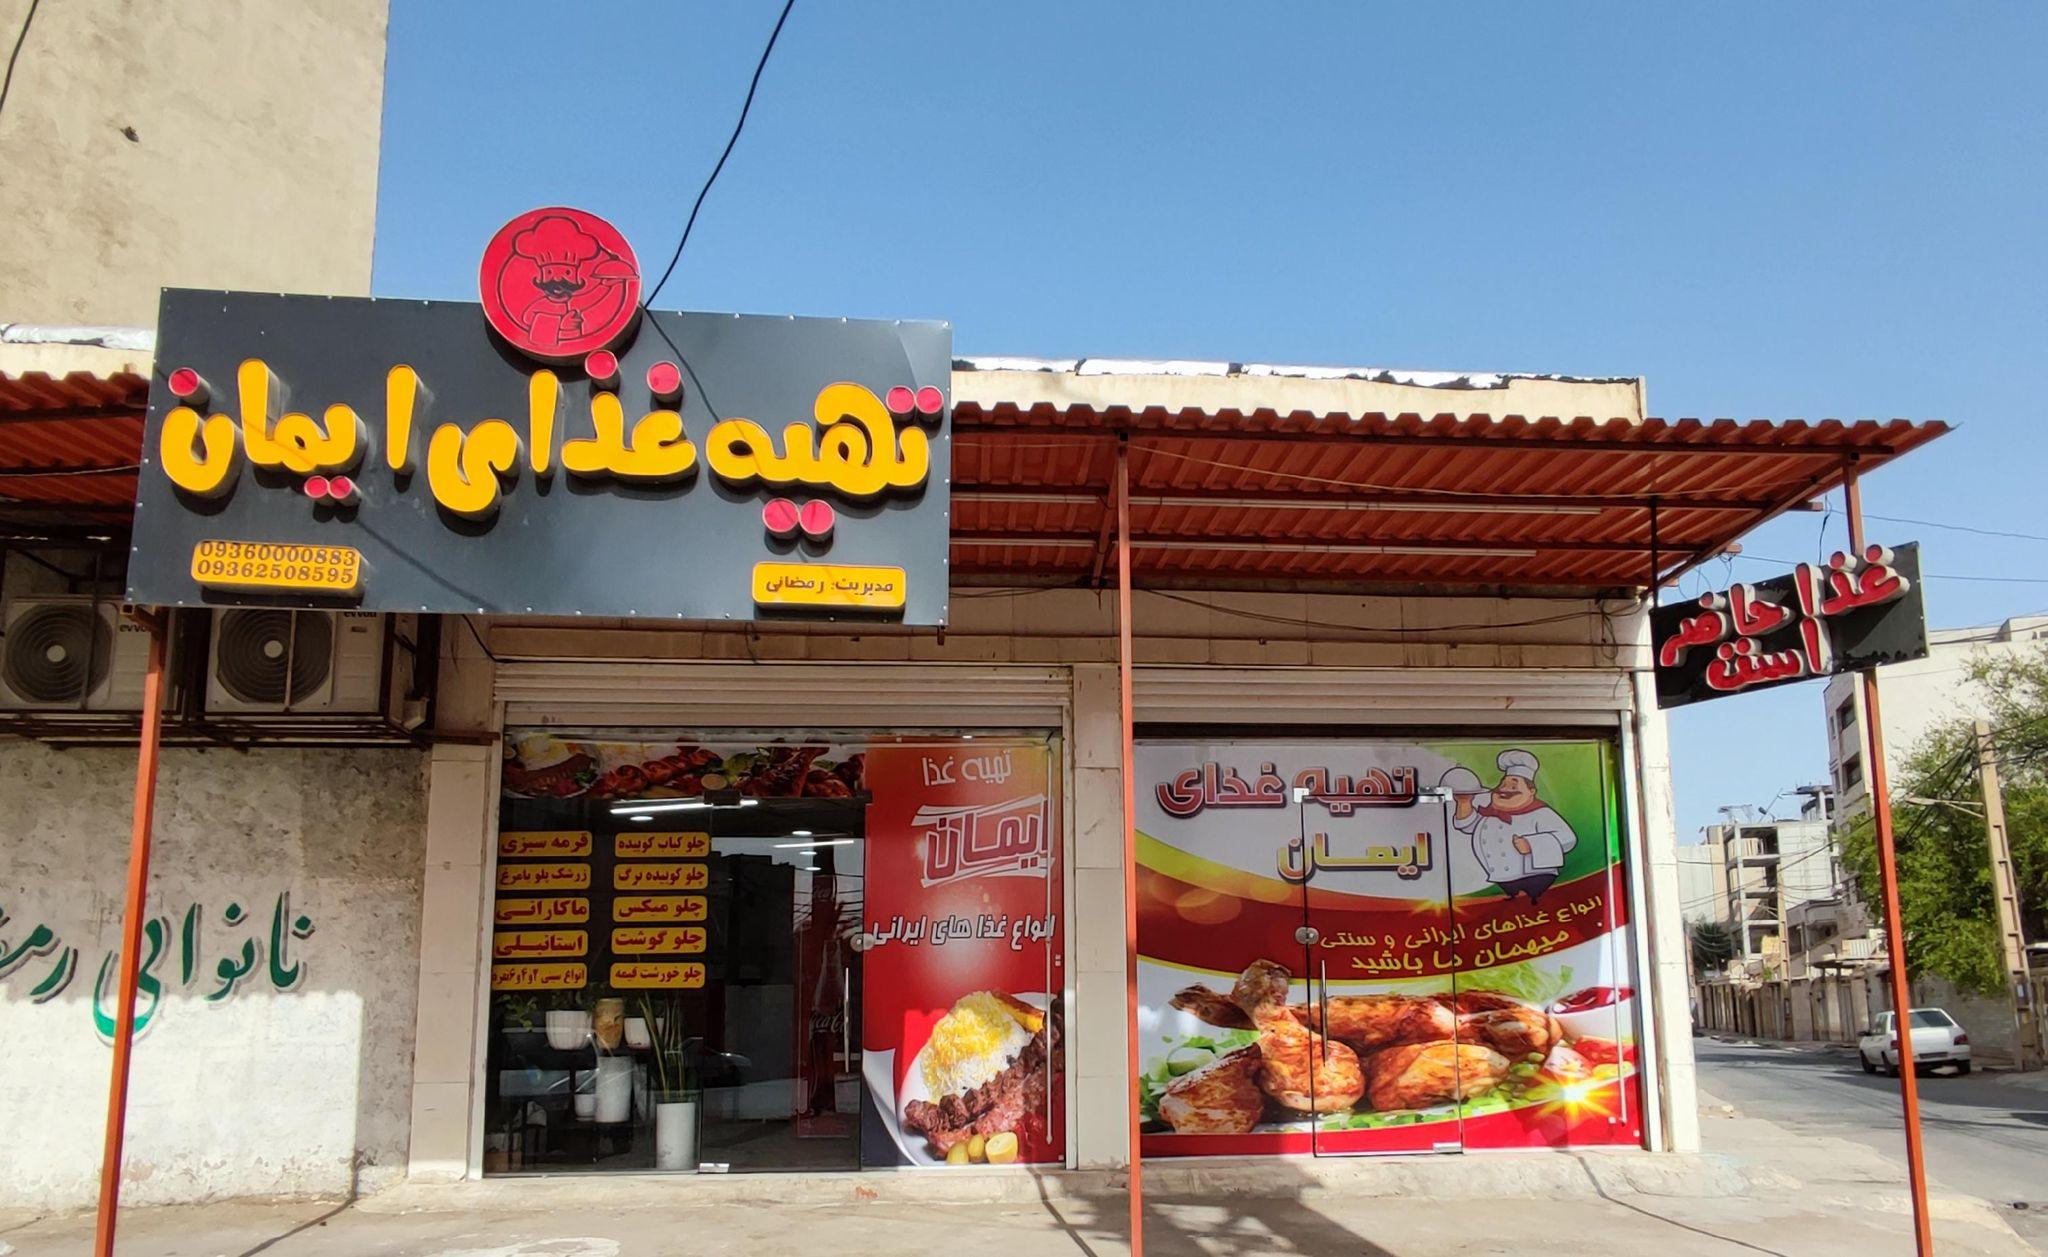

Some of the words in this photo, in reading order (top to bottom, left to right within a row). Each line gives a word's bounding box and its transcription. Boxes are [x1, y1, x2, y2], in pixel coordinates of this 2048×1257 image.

[160, 359, 418, 499] ایمان
[428, 352, 697, 513] غذای
[706, 383, 943, 533] تهیه
[200, 540, 356, 566] 09360000883
[197, 559, 354, 583] 09362508595
[1795, 543, 1909, 617] غذا
[766, 576, 825, 593] رمضانی
[1660, 583, 1793, 667] حاضر
[1706, 616, 1831, 690] است
[922, 756, 956, 786] غذا
[961, 750, 1012, 785] تهیه
[1156, 762, 1285, 816] غذای
[1293, 766, 1417, 815] تهیه
[502, 837, 547, 853] سبزی
[551, 833, 588, 853] قرمه
[618, 836, 655, 853] کوبیده
[657, 836, 683, 852] کباب
[686, 837, 705, 852] چلو
[925, 799, 1054, 881] ایمان
[1277, 832, 1431, 882] ایمان
[535, 868, 549, 884] پلو
[551, 867, 588, 882] زرشک
[618, 868, 643, 886] برگ
[646, 868, 682, 885] کوبیده
[685, 867, 704, 885] چلو
[619, 899, 668, 918] میکس
[673, 898, 703, 918] چلو
[1557, 896, 1602, 922] انواع
[873, 915, 927, 945] ایرانی
[931, 915, 972, 945] های
[976, 915, 1008, 938] غذا
[1011, 914, 1056, 950] انواع
[1404, 923, 1466, 949] ایرانی
[1474, 910, 1550, 940] غذاهای
[615, 930, 668, 950] گوشت
[672, 930, 703, 950] چلو
[1320, 930, 1376, 948] سنتی
[1384, 933, 1394, 949] و
[1474, 928, 1570, 967] میهمان
[1352, 950, 1423, 975] باشید
[1433, 950, 1463, 968] ما
[563, 968, 585, 984] انواع
[615, 966, 638, 981] قیمه
[640, 966, 680, 982] خورشت
[683, 966, 702, 983] چلو
